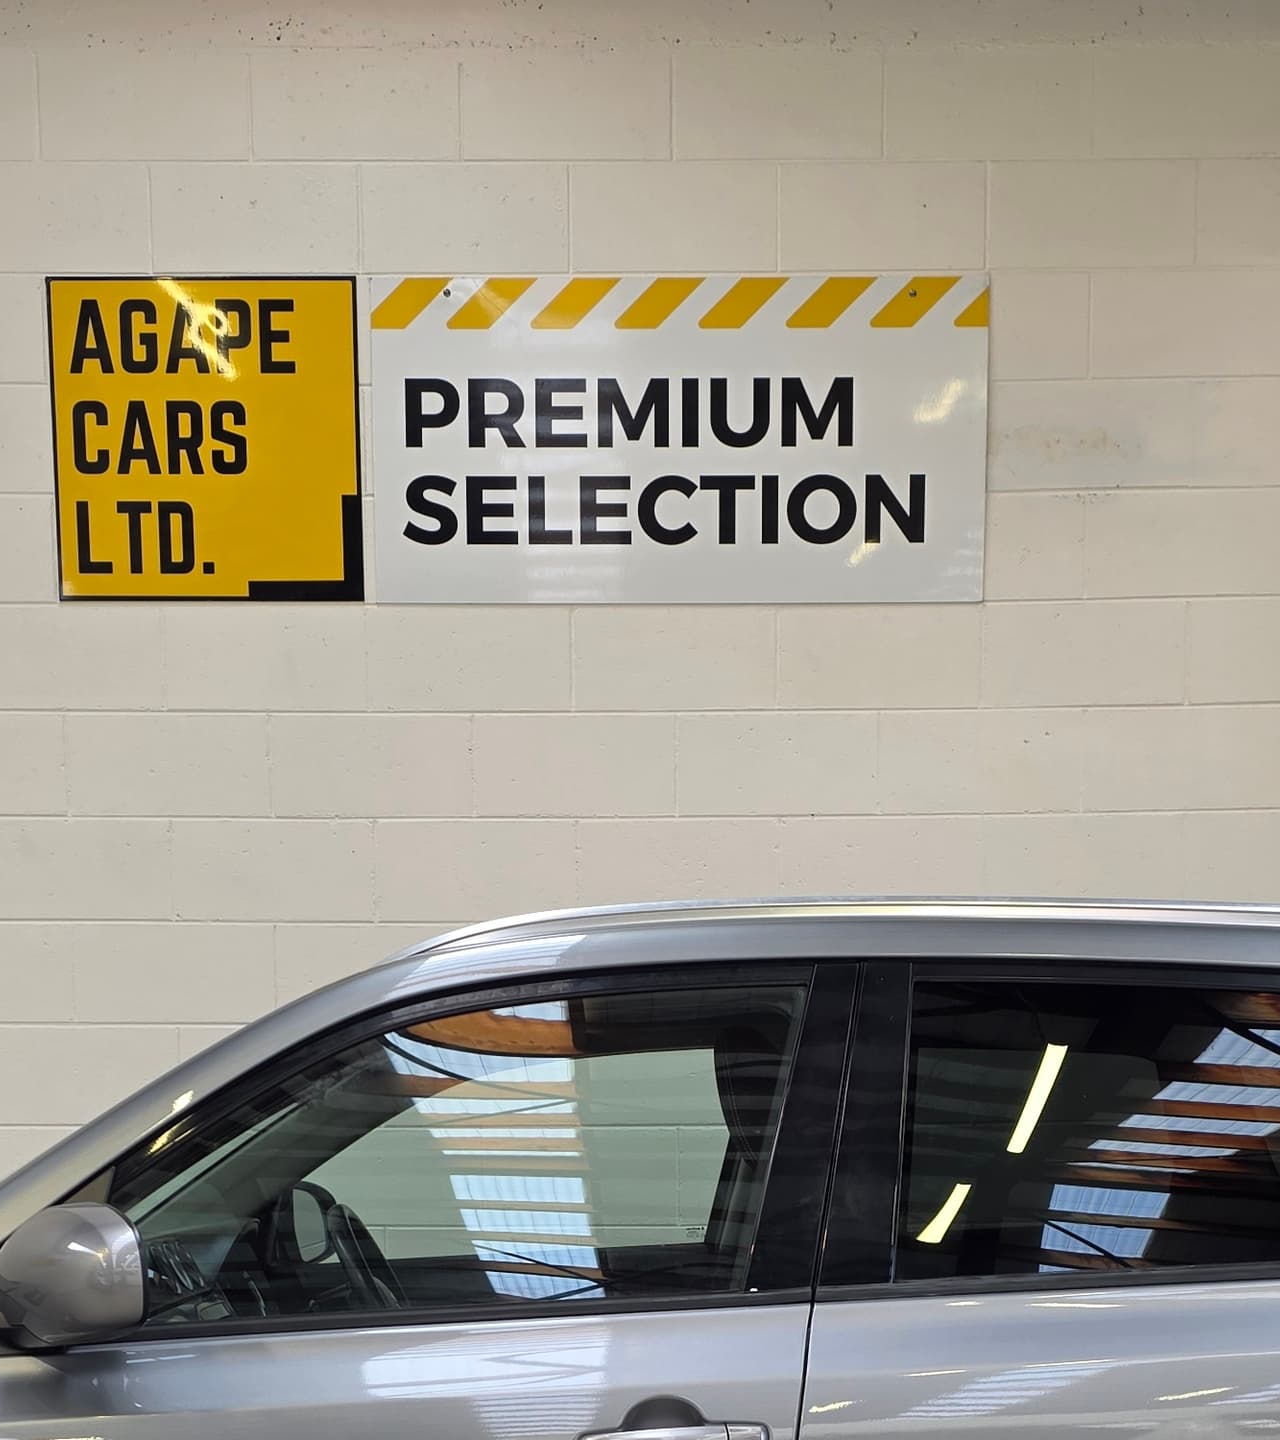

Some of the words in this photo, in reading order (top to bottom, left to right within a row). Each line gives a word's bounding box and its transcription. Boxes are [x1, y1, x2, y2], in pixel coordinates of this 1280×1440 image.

[69, 298, 297, 375] AGAPE
[72, 400, 249, 475] CARS
[404, 376, 855, 449] PREMIUM
[75, 500, 216, 575] LTD.
[402, 474, 927, 546] SELECTION
